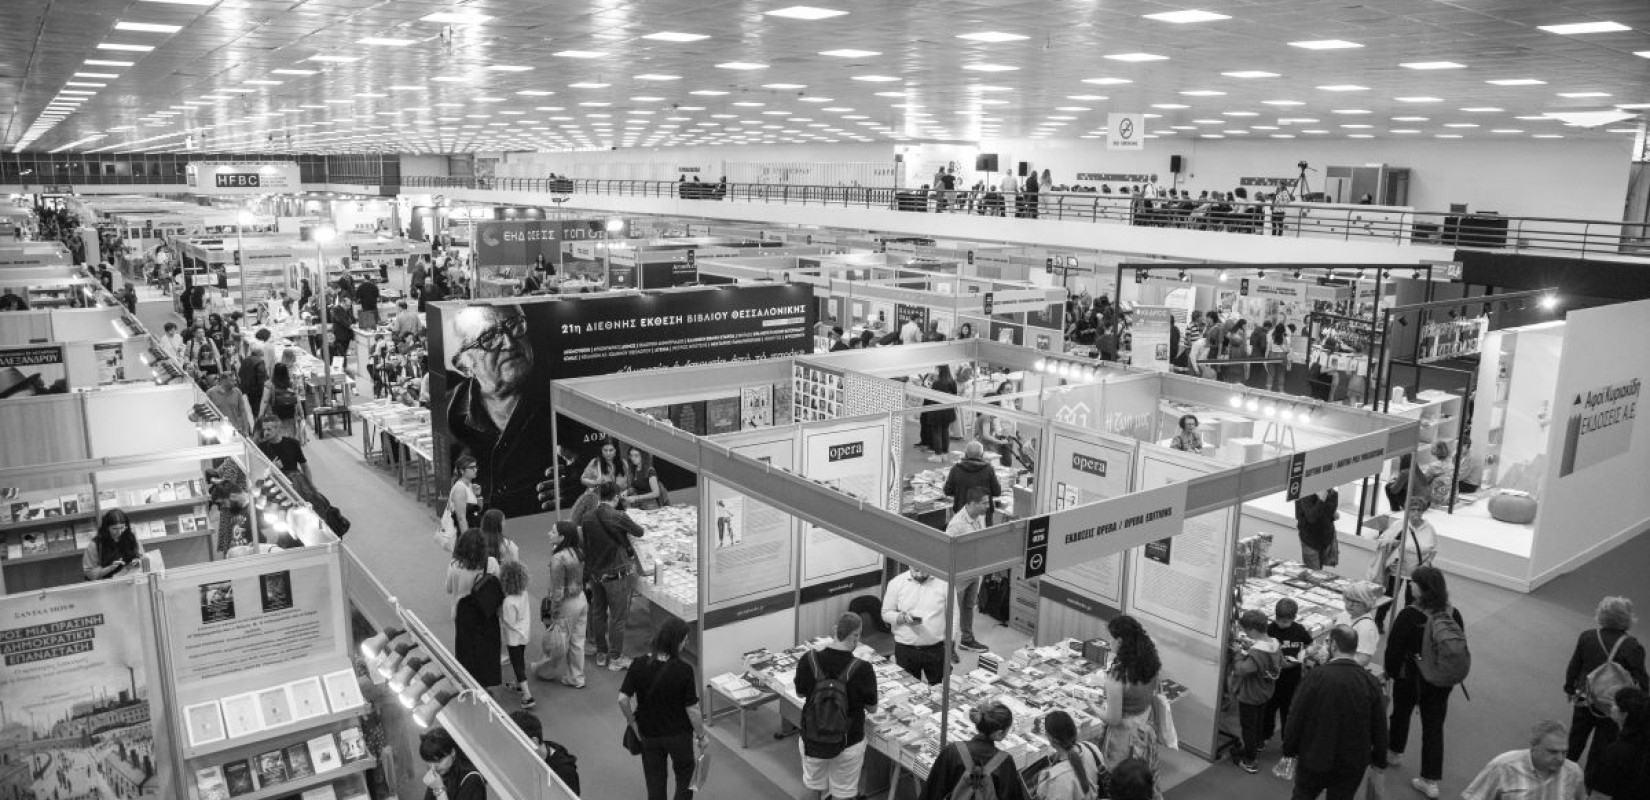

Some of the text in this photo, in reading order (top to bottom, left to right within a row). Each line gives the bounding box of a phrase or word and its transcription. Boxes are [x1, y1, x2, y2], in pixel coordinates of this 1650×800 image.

[217, 175, 258, 186] HFBC
[561, 304, 807, 335] 21η ΔΙΕΘΝΗΣ ΕΚΘΕΣΗ ΒΙΒΛΙΟΥ ΘΕΣΣΑΛΟΝΙΚΗΣ
[830, 443, 862, 460] opera
[1073, 455, 1105, 473] opera
[25, 625, 48, 638] ΜΙΑ
[51, 615, 102, 631] ΠΡΑΣΙΝΗ
[4, 630, 92, 653] ΔΗΜΟΚΡΑΤΙΚΗ
[9, 643, 90, 664] ΕΠΑΝΑΣΤΑΣΗ
